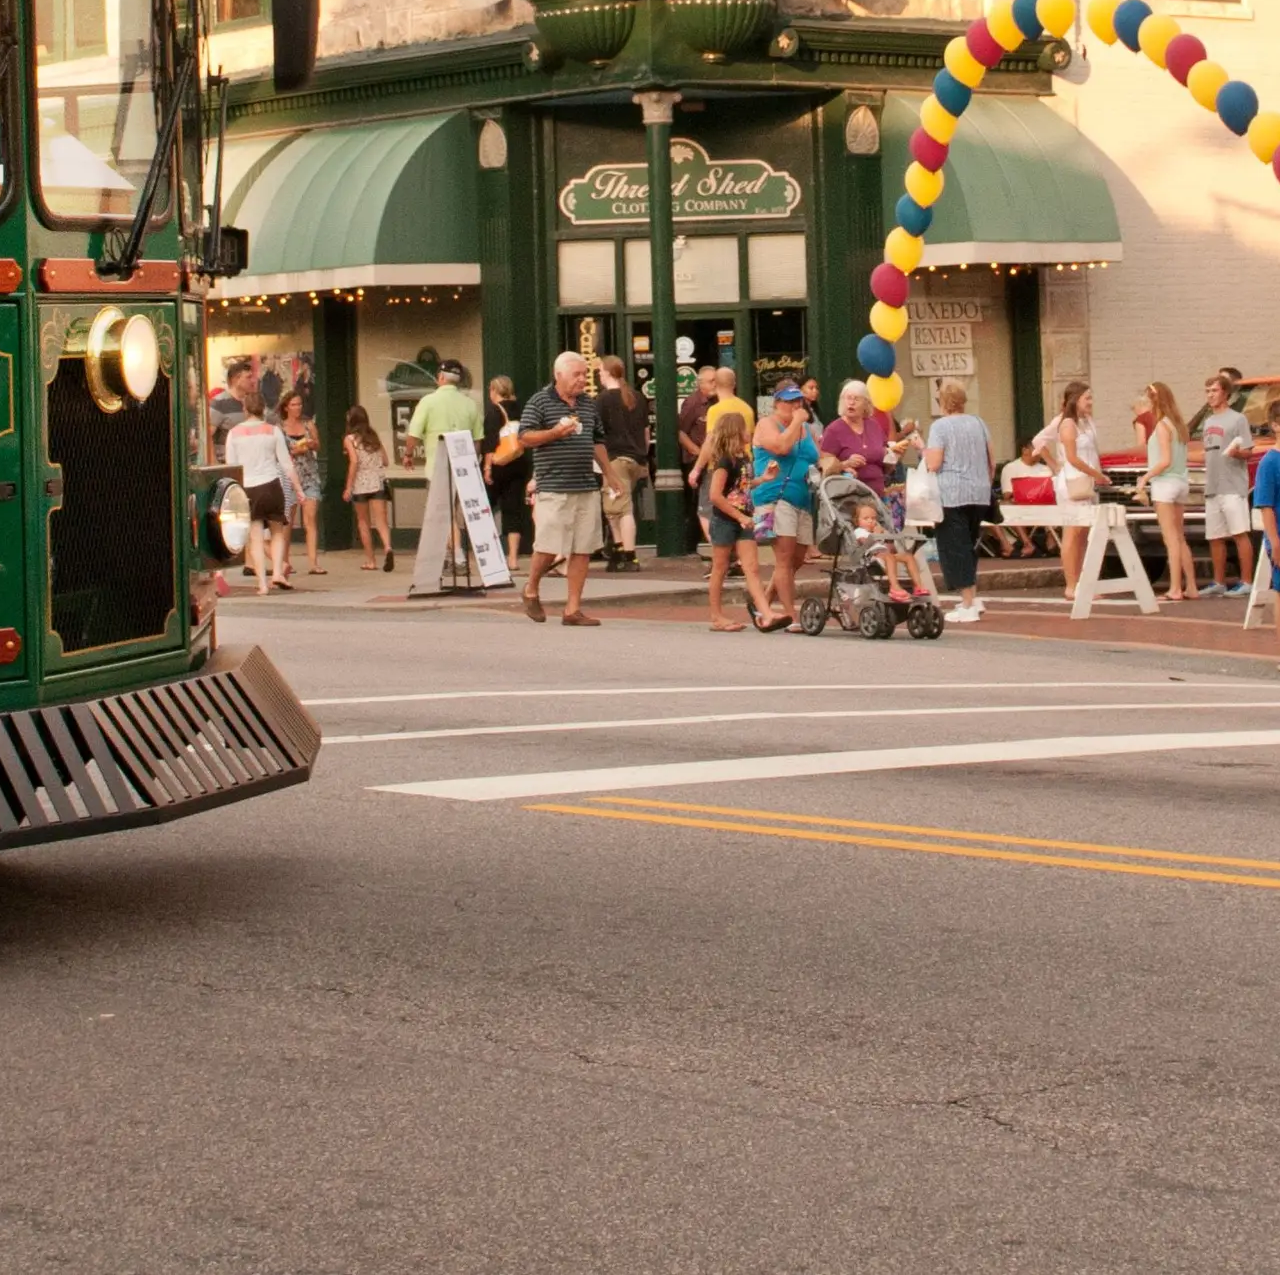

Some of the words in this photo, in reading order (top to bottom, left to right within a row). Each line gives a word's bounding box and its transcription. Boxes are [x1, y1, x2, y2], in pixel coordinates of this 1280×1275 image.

[591, 171, 690, 200] Thred
[697, 167, 770, 197] Shed
[684, 199, 748, 213] COMPANY
[907, 302, 979, 320] TUXEDO
[914, 327, 967, 345] RENTALS
[915, 354, 926, 372] &
[931, 353, 968, 371] SALES
